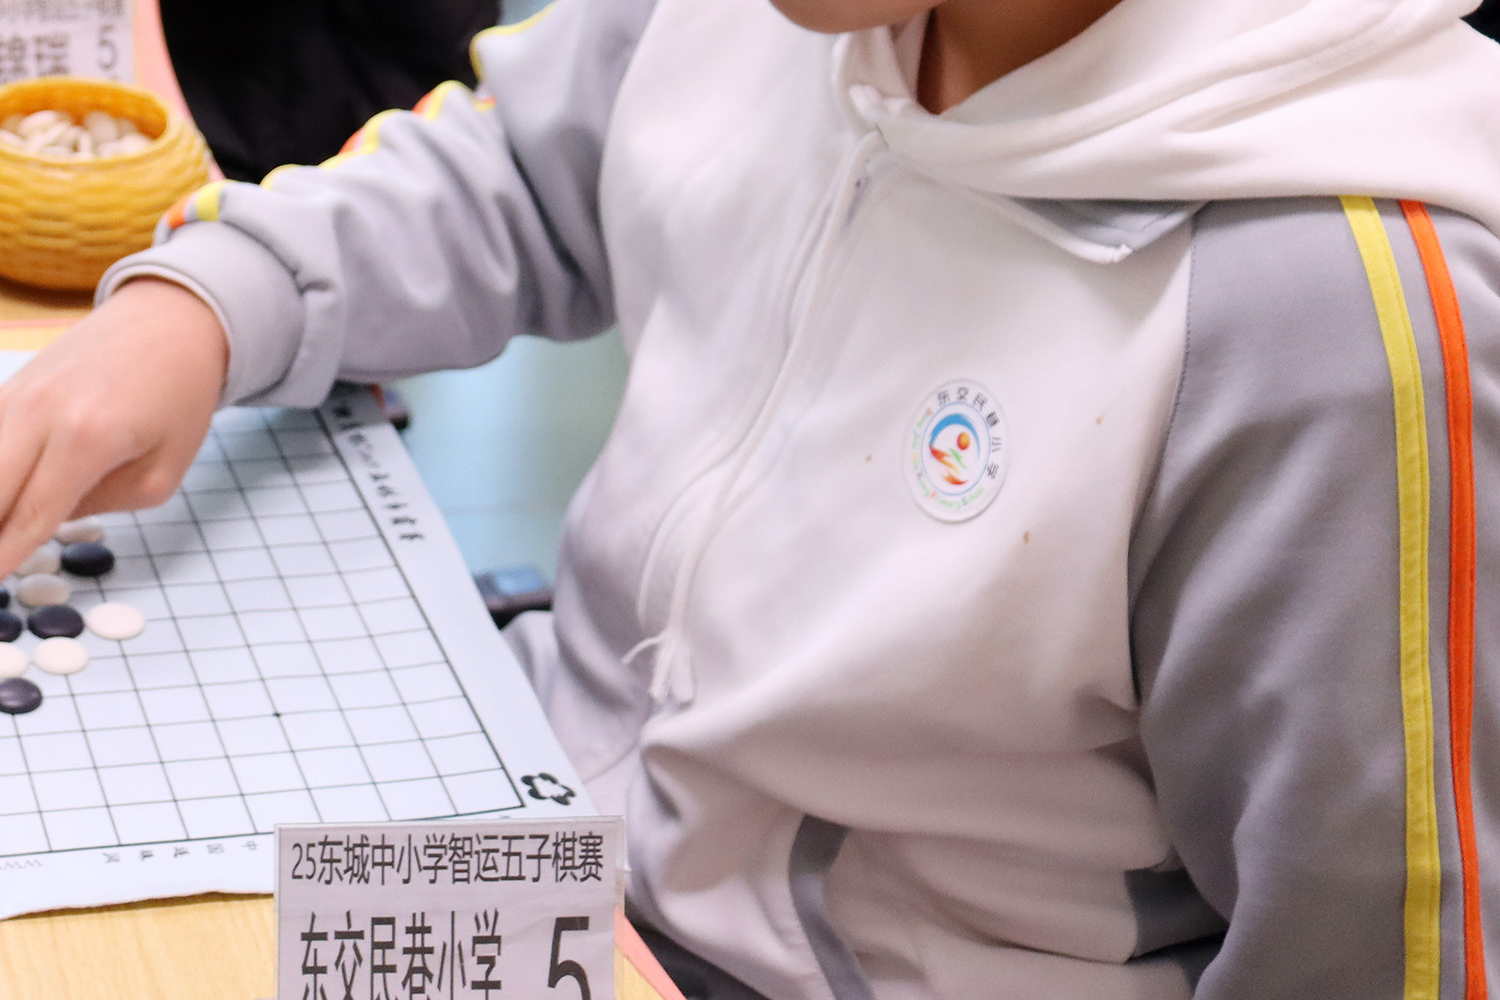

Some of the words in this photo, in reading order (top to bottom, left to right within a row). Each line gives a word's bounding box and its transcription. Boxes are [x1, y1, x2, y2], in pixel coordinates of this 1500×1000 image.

[97, 25, 119, 71] 5
[291, 831, 605, 885] 25东城中小学智运五子棋赛
[300, 908, 503, 1000] 东交民巷小学
[547, 915, 592, 1000] 5
